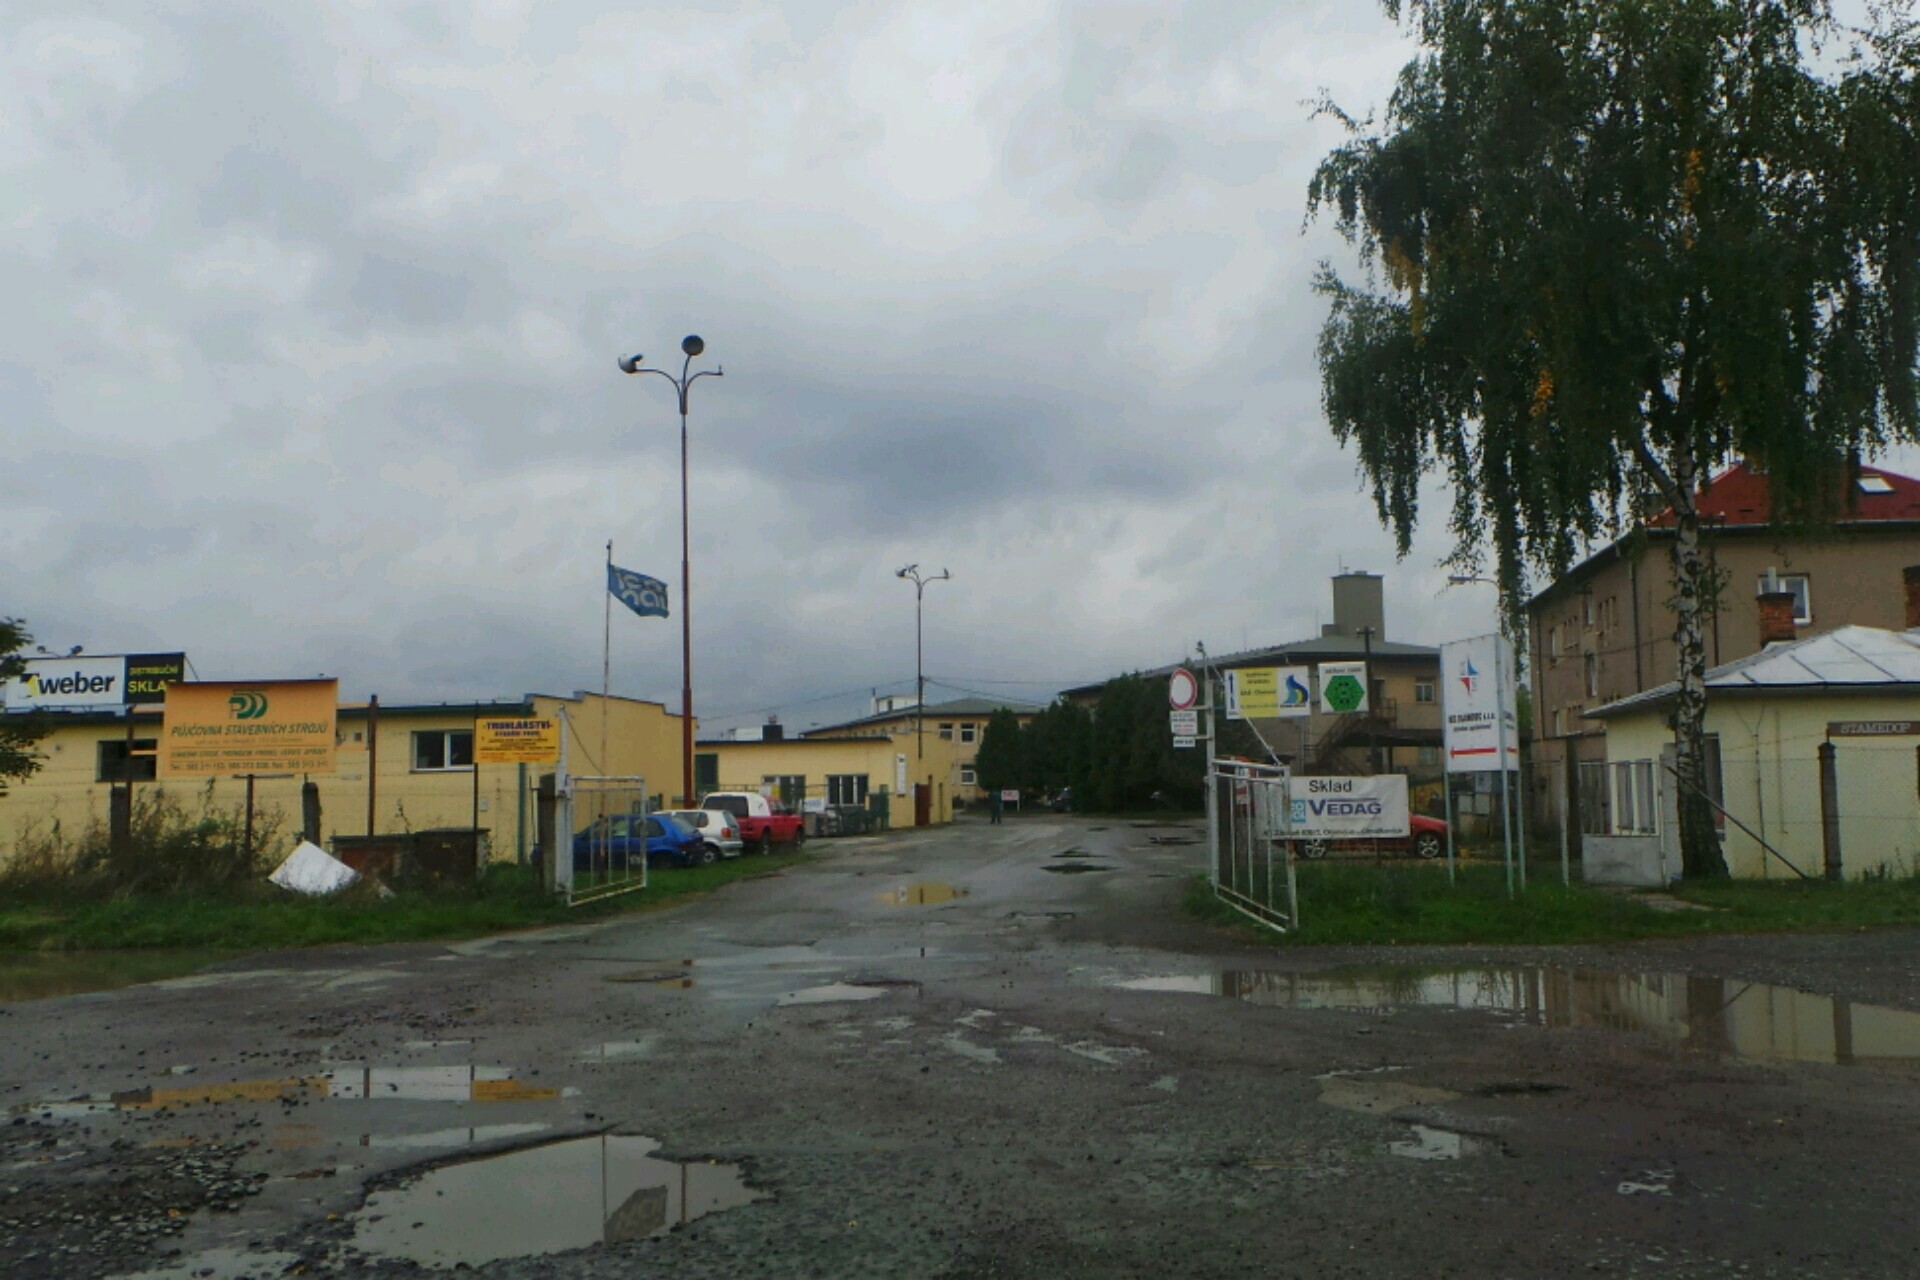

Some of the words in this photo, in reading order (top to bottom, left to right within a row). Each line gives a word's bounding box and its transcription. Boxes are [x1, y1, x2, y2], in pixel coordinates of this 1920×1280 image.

[38, 671, 115, 694] weber
[171, 723, 222, 737] PŮJČOVNA
[225, 721, 287, 737] STAVEBNÍCH
[289, 720, 328, 734] STROJŮ
[1309, 779, 1352, 793] Sklad
[1308, 799, 1382, 816] VEDAG
